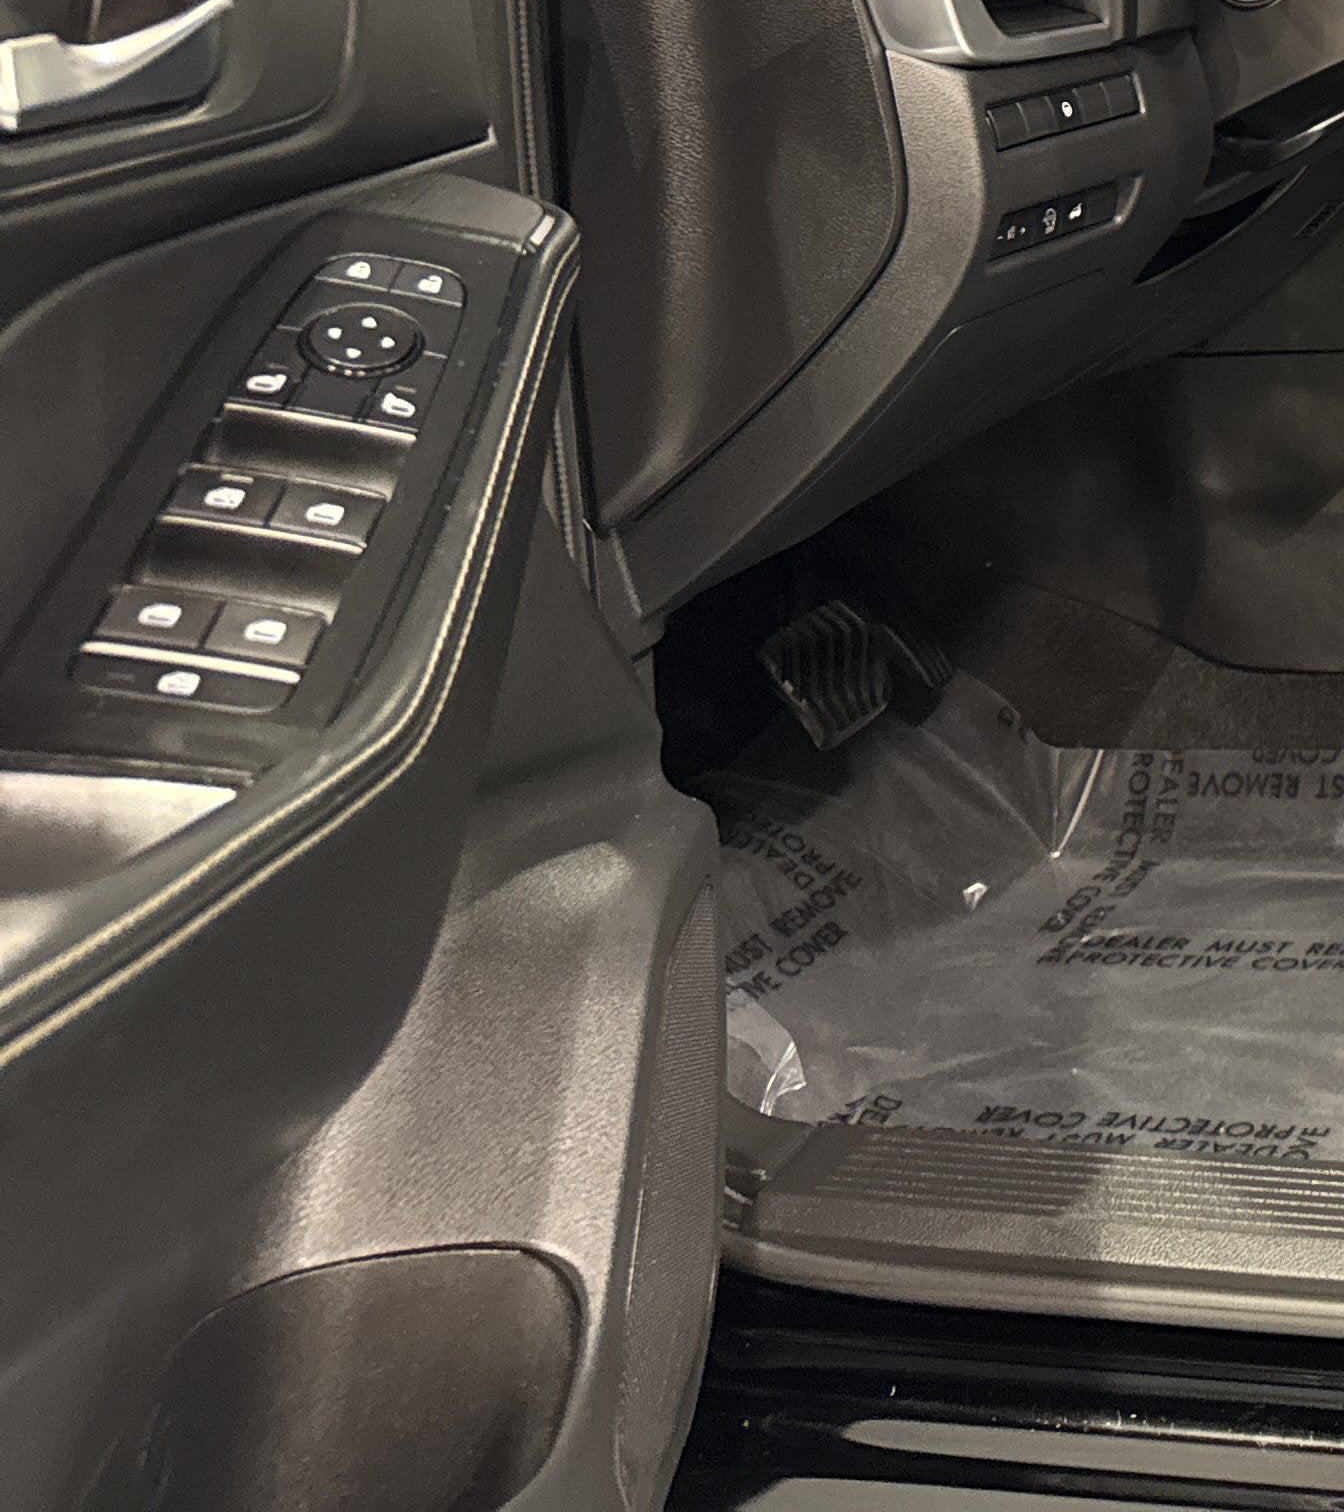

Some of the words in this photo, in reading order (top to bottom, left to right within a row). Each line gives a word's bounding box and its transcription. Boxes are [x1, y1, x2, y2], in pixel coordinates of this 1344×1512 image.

[1188, 770, 1300, 799] REMOVE
[1151, 756, 1185, 844] EALER
[1083, 934, 1190, 952] DEALER
[1206, 938, 1295, 956] MUST
[1064, 950, 1244, 970] PROTECTIVE
[975, 1104, 1086, 1129] COVER
[1097, 1110, 1292, 1140] PROTECTIVE
